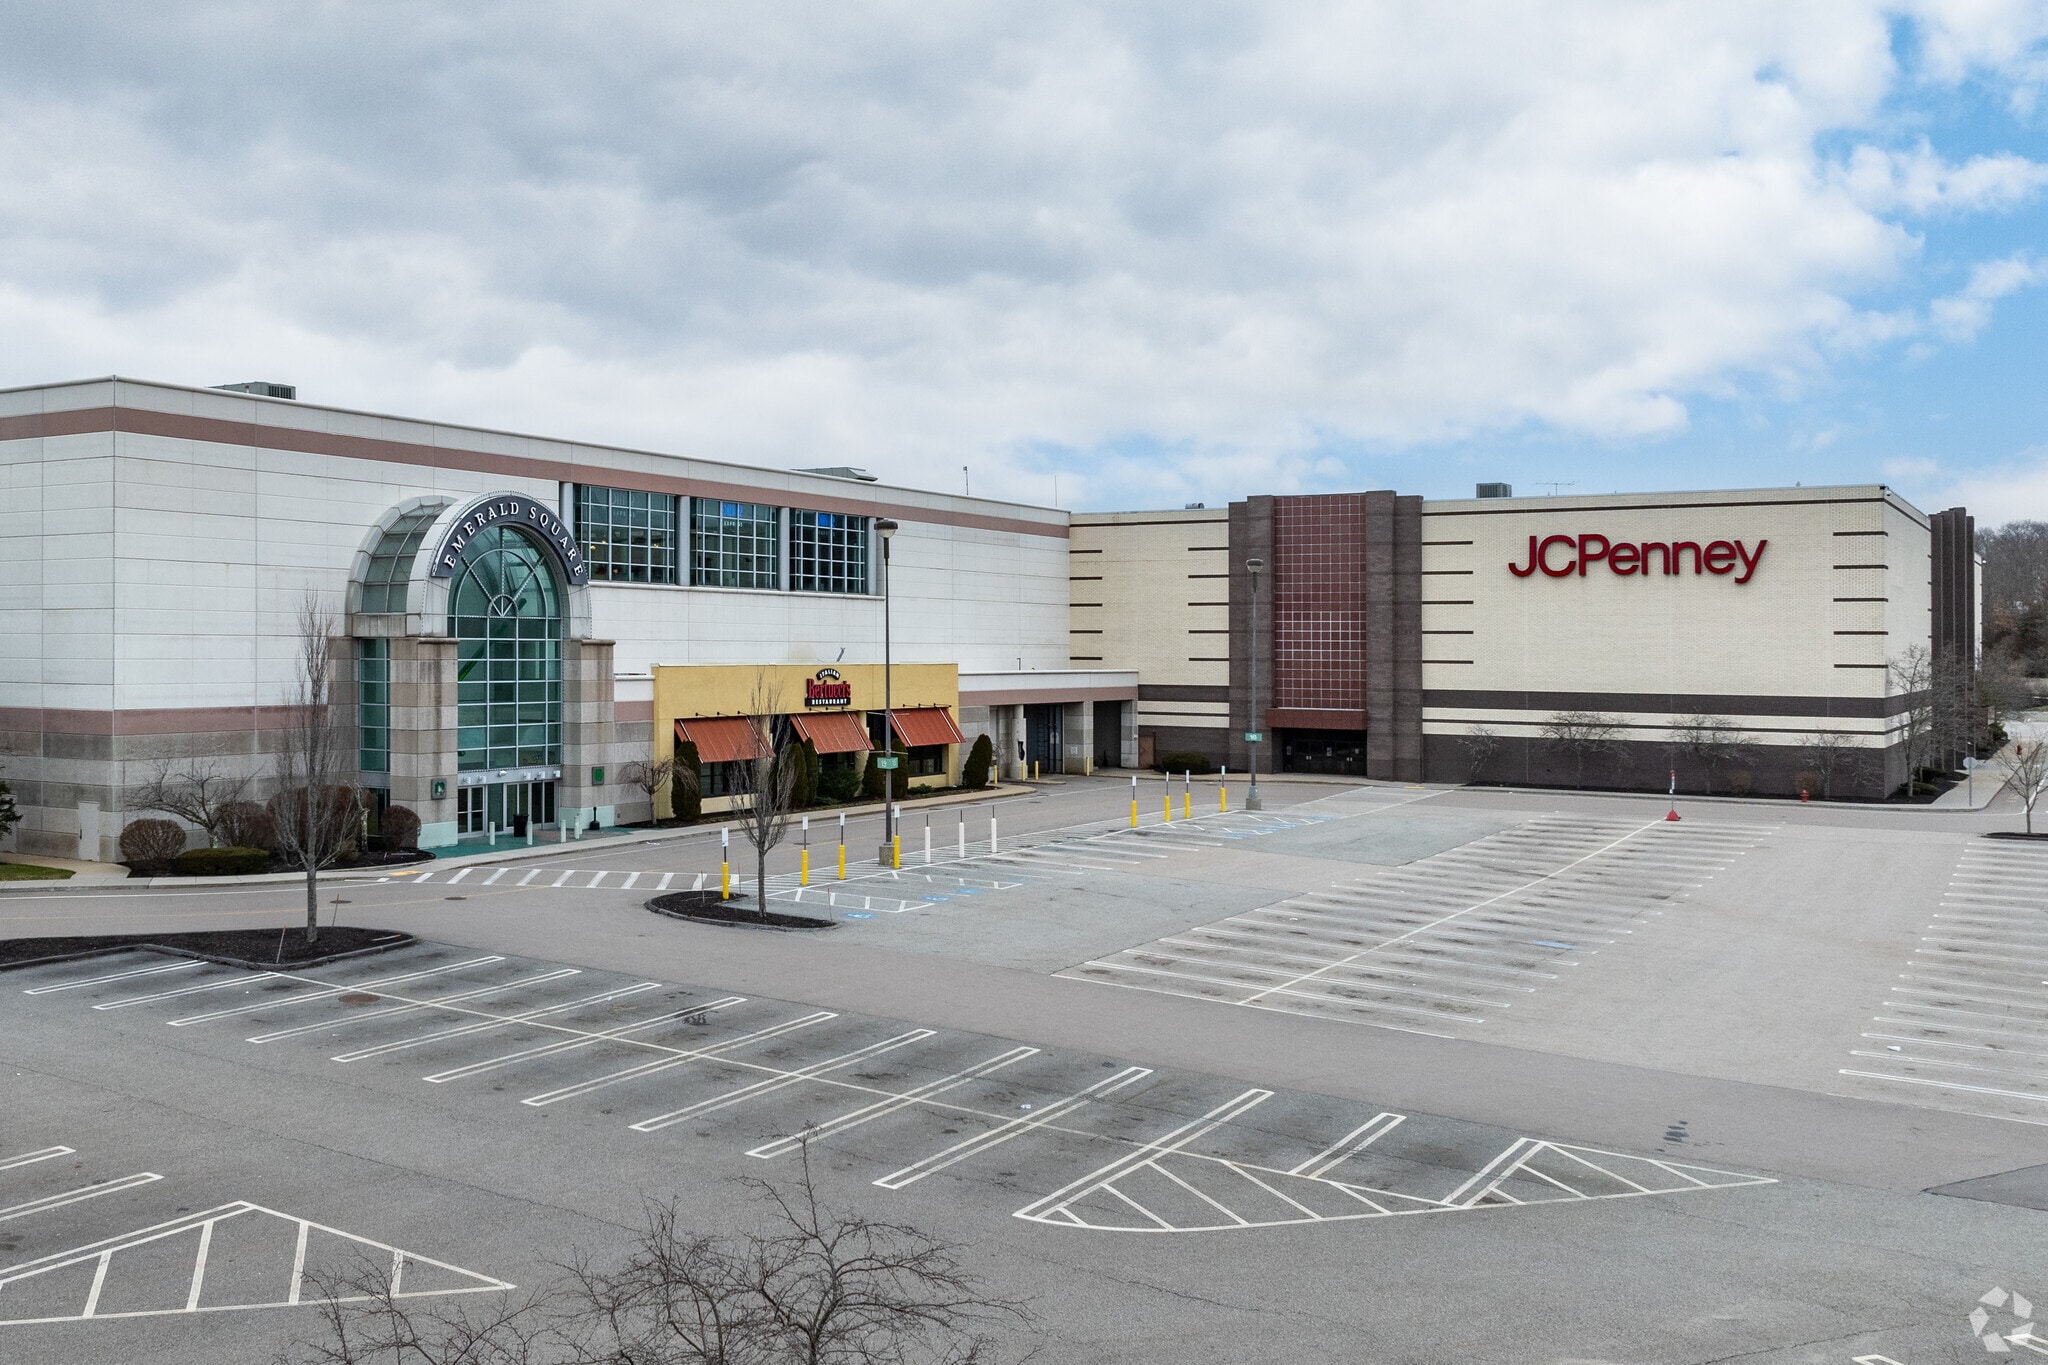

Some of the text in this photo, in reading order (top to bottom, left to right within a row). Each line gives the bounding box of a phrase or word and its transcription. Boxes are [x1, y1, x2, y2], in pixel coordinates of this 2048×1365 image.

[443, 502, 583, 577] EMERALD SQUARE
[1508, 534, 1768, 584] JCPenney
[806, 678, 851, 698] Bertucci's
[819, 669, 840, 679] ITALIAN
